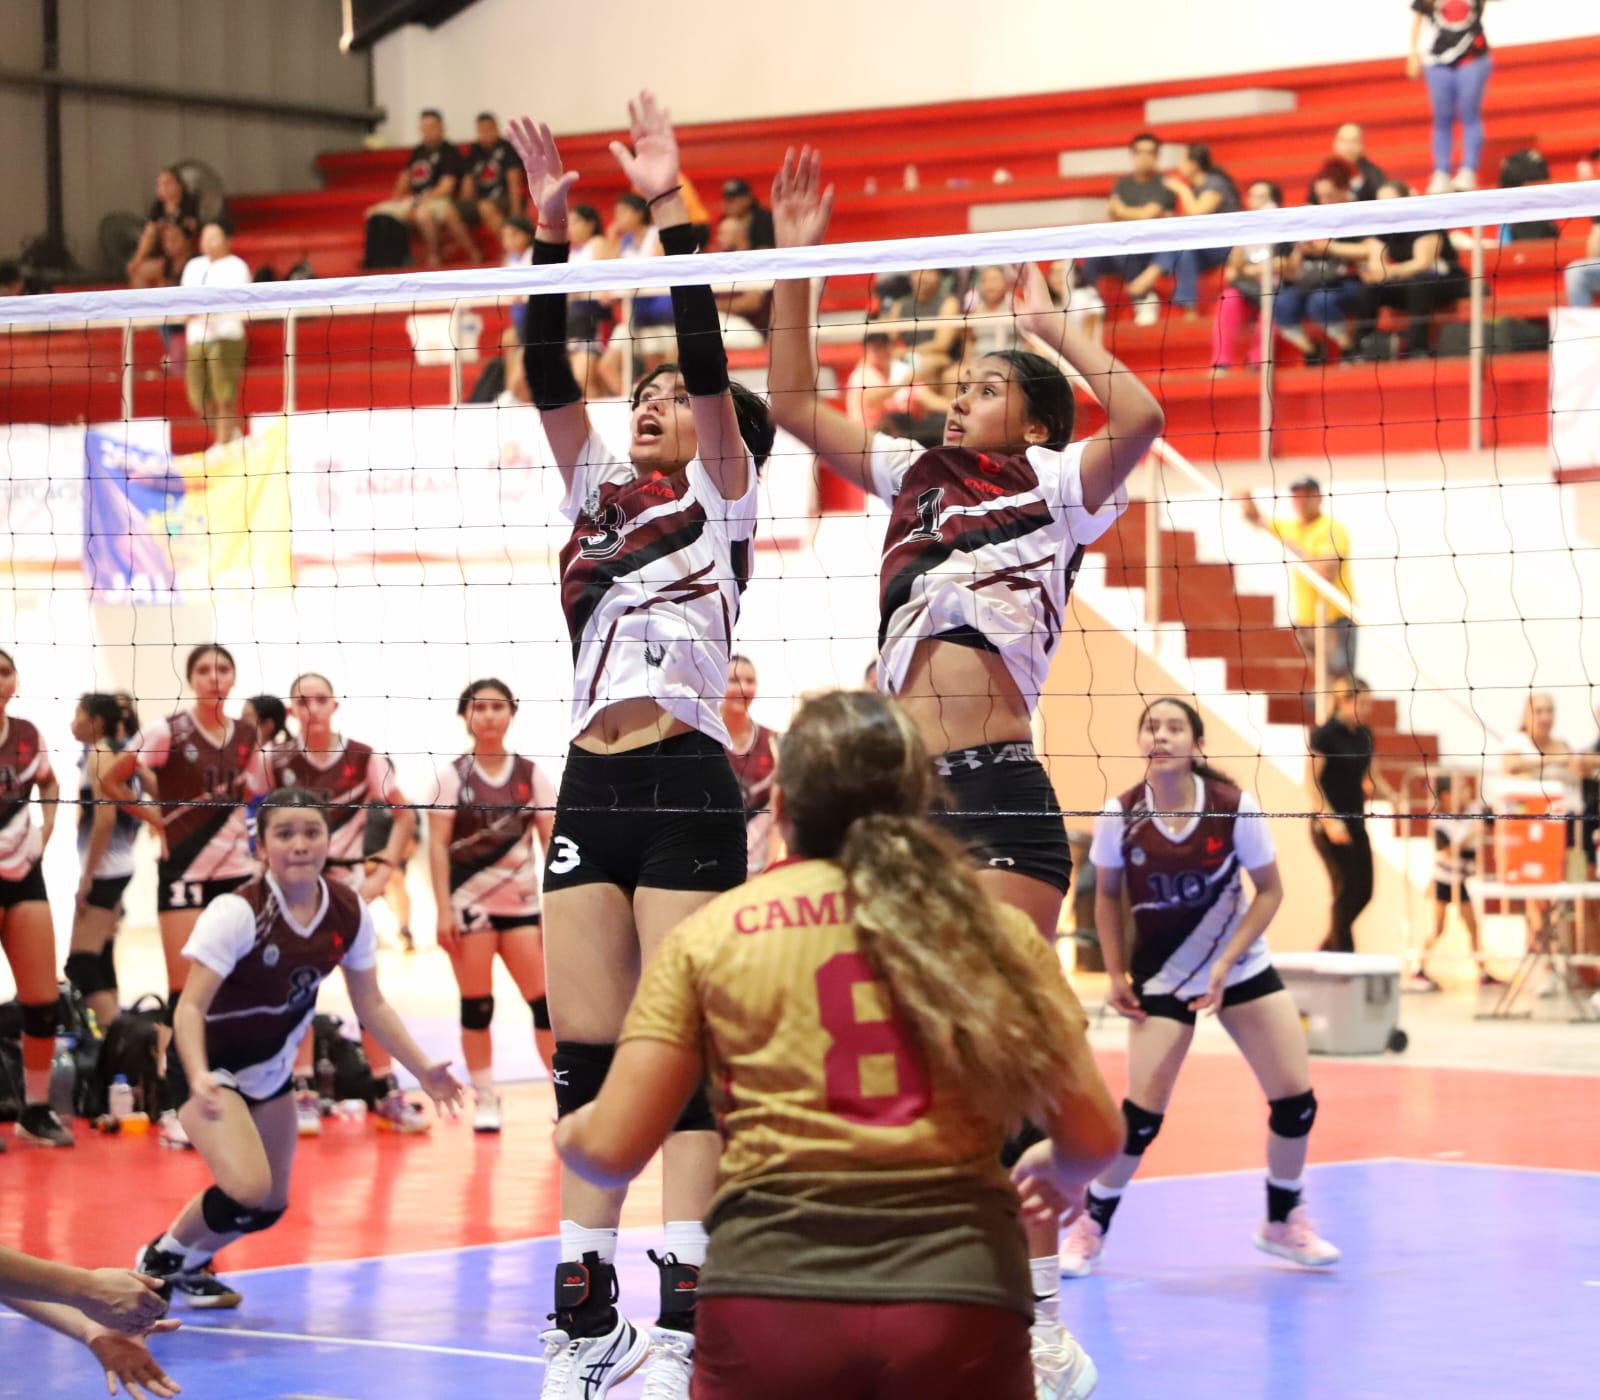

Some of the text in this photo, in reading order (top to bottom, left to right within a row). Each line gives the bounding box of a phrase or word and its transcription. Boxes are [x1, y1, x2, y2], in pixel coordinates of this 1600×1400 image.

[577, 502, 627, 560] 3
[908, 487, 944, 543] 1
[548, 835, 582, 875] 3
[169, 880, 203, 907] 11
[1147, 870, 1210, 906] 10
[288, 966, 322, 1010] 8
[815, 950, 931, 1127] 8
